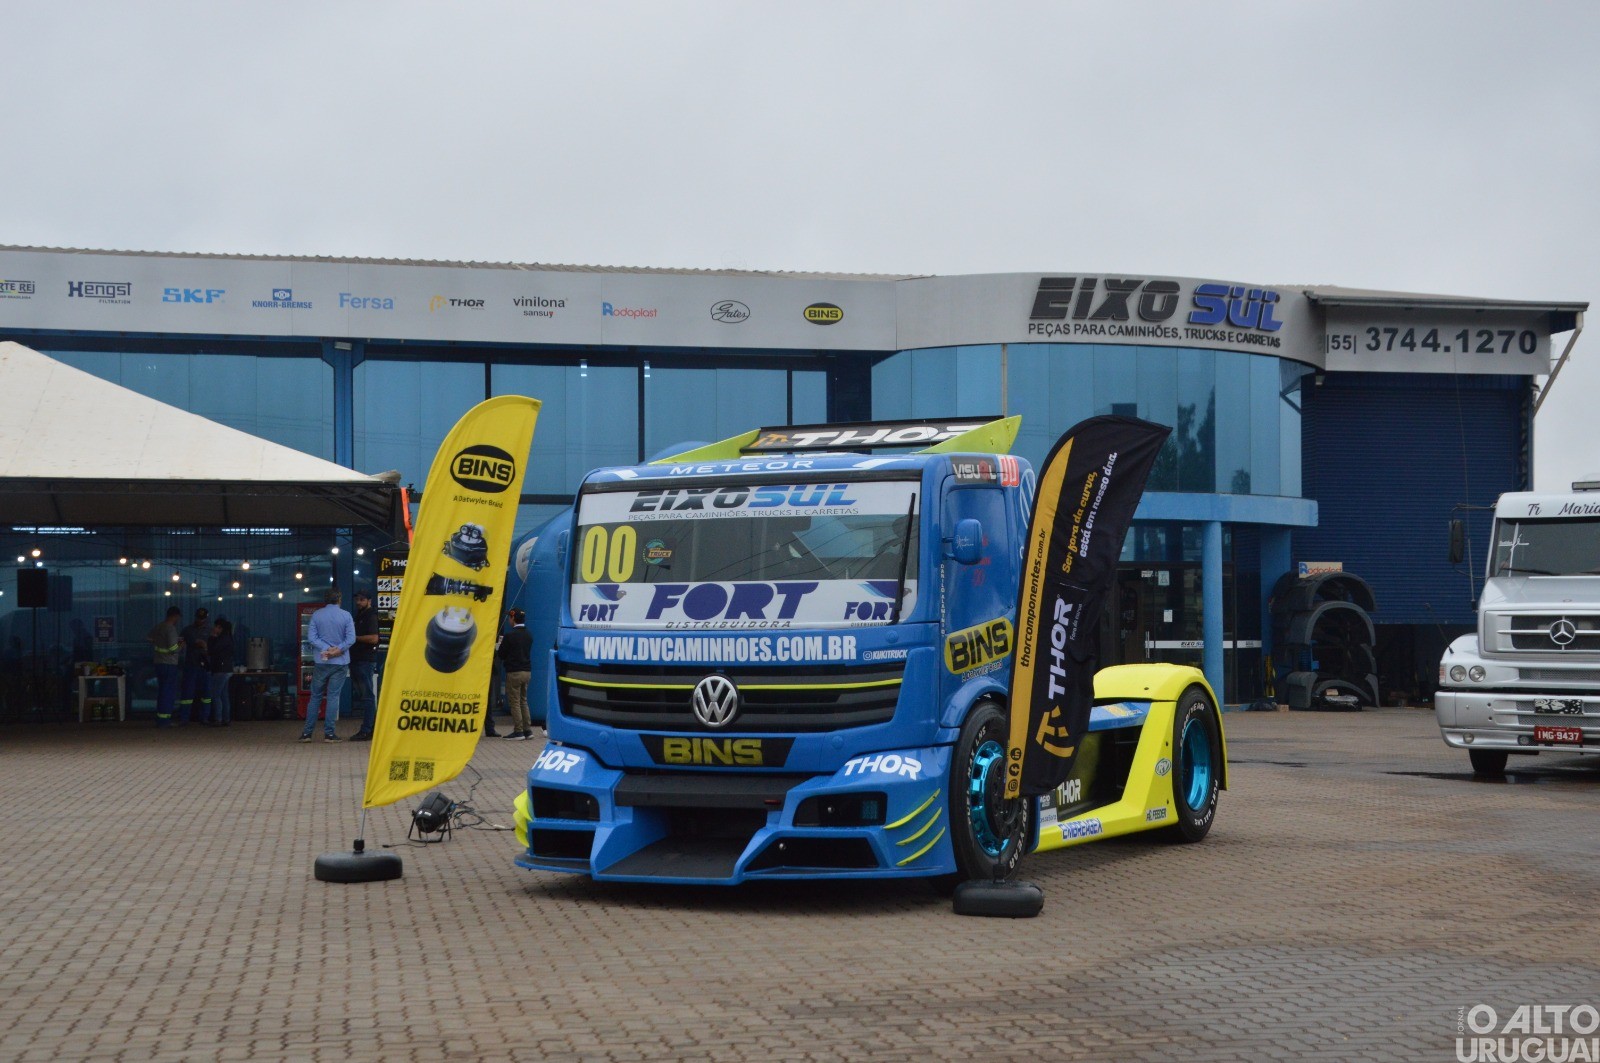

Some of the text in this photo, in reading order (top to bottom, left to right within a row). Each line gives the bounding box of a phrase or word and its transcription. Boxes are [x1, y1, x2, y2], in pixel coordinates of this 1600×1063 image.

[68, 281, 132, 299] Hengst
[163, 288, 226, 304] SKF
[252, 300, 313, 309] KNORR-BREMSE
[339, 292, 395, 310] Fersa
[449, 298, 485, 307] THOR
[513, 296, 566, 308] vinilona
[602, 301, 658, 319] Rodoplast
[1029, 277, 1284, 332] EIXO SUL
[523, 309, 554, 318] sansuy
[711, 302, 750, 321] Gates
[808, 309, 839, 319] BINS
[1028, 323, 1281, 348] PEÇAS PARA CAMINHÕES, TRUCKS E CARRETAS
[1366, 327, 1537, 354] 3744.1270
[457, 458, 512, 482] BINS
[669, 460, 815, 475] METEOR
[1080, 452, 1118, 558] está em nosso dna.
[1528, 503, 1542, 516] Tr
[628, 507, 859, 522] PEÇAS PARA CAMINHÕES, TRUCKS E CARRETAS
[1062, 471, 1098, 573] Ser fora da curva,
[392, 559, 408, 567] THO
[581, 525, 637, 583] 00
[645, 582, 819, 621] FORT
[1021, 528, 1046, 668] thorcomponentes.com.br
[579, 604, 619, 621] FORT
[666, 620, 791, 629] DISTRIBUIDORA
[584, 636, 857, 662] WWW.DVCAMINHOES.COM.BR
[948, 621, 1009, 671] BINS
[1049, 597, 1073, 700] THOR
[400, 698, 480, 715] QUALIDADE
[397, 715, 478, 733] ORIGINAL
[663, 738, 763, 765] BINS
[531, 749, 581, 773] HOR
[844, 754, 922, 780] THOR
[1057, 779, 1081, 806] THOR
